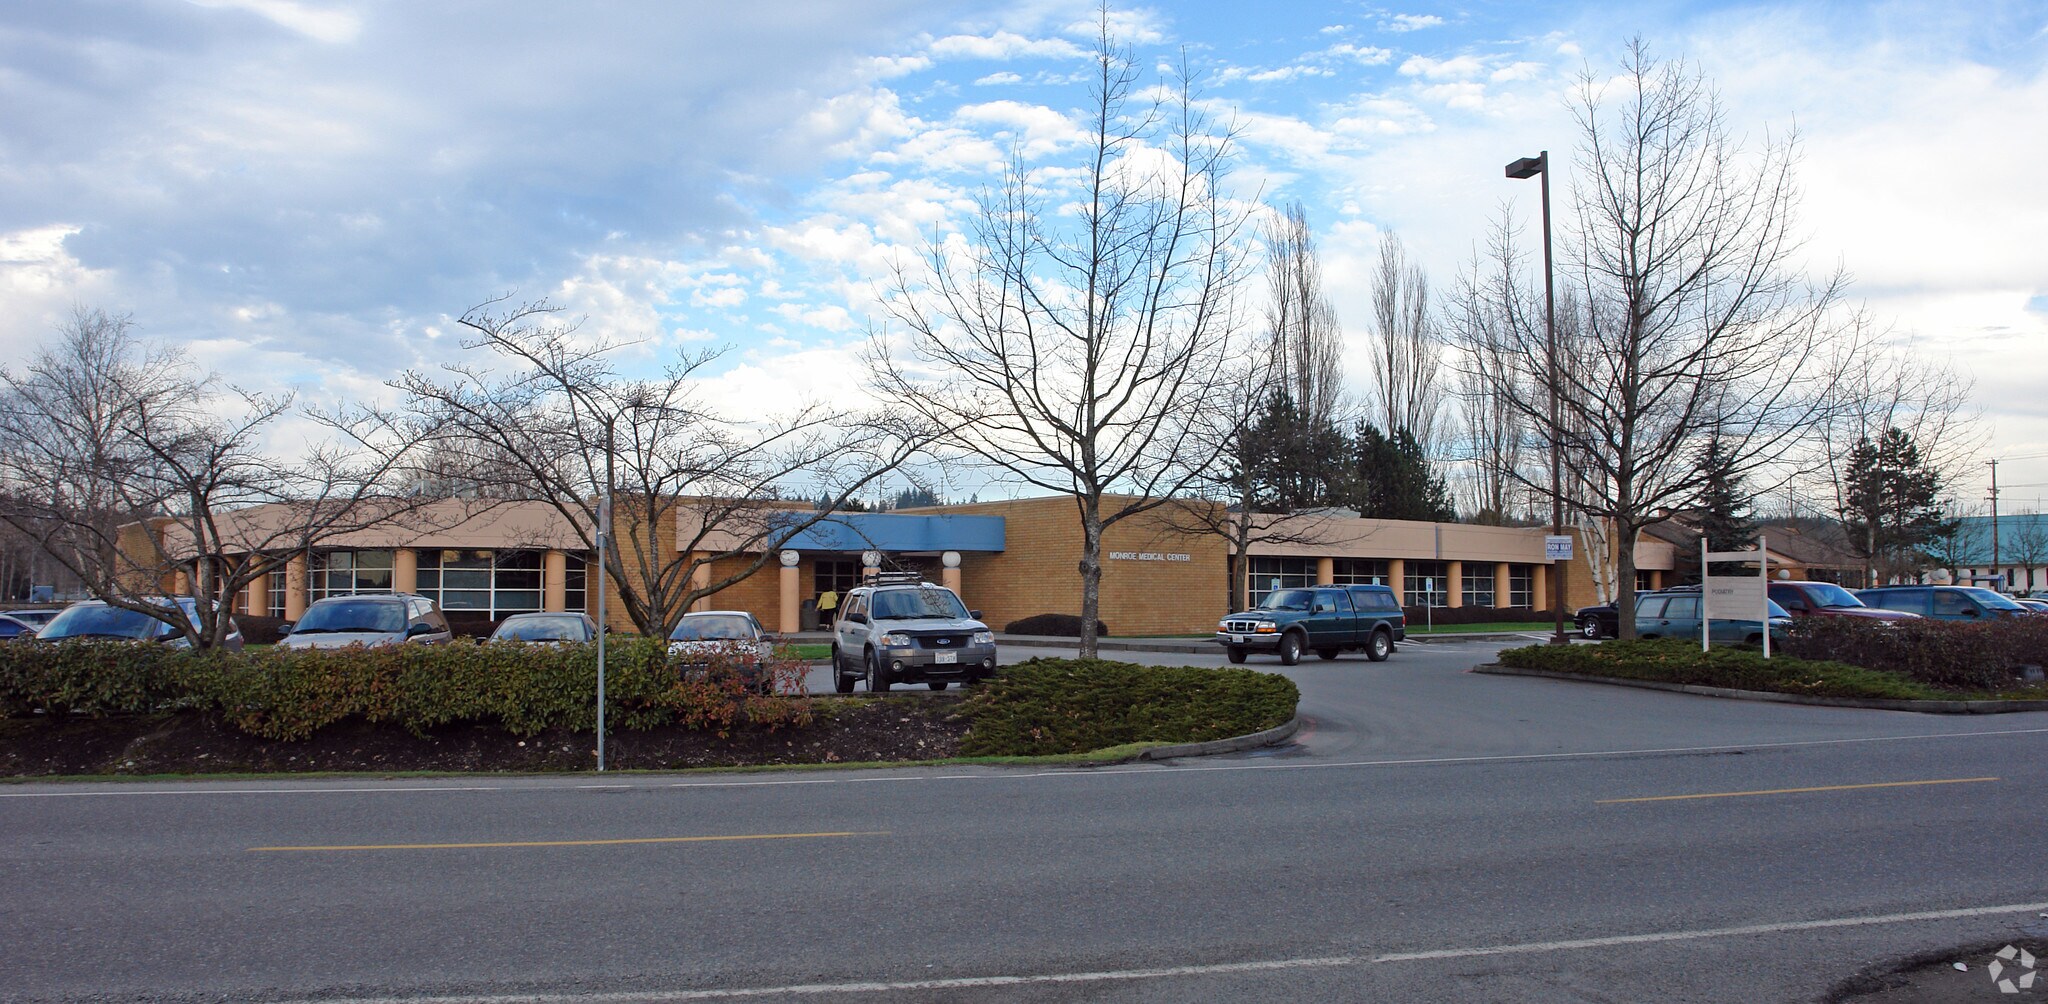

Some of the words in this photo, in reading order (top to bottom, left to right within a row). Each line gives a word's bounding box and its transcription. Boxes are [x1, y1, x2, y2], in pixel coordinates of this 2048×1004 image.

[1109, 551, 1137, 560] MONROE
[1139, 552, 1165, 561] MEDICAL
[1167, 553, 1191, 561] CENTER
